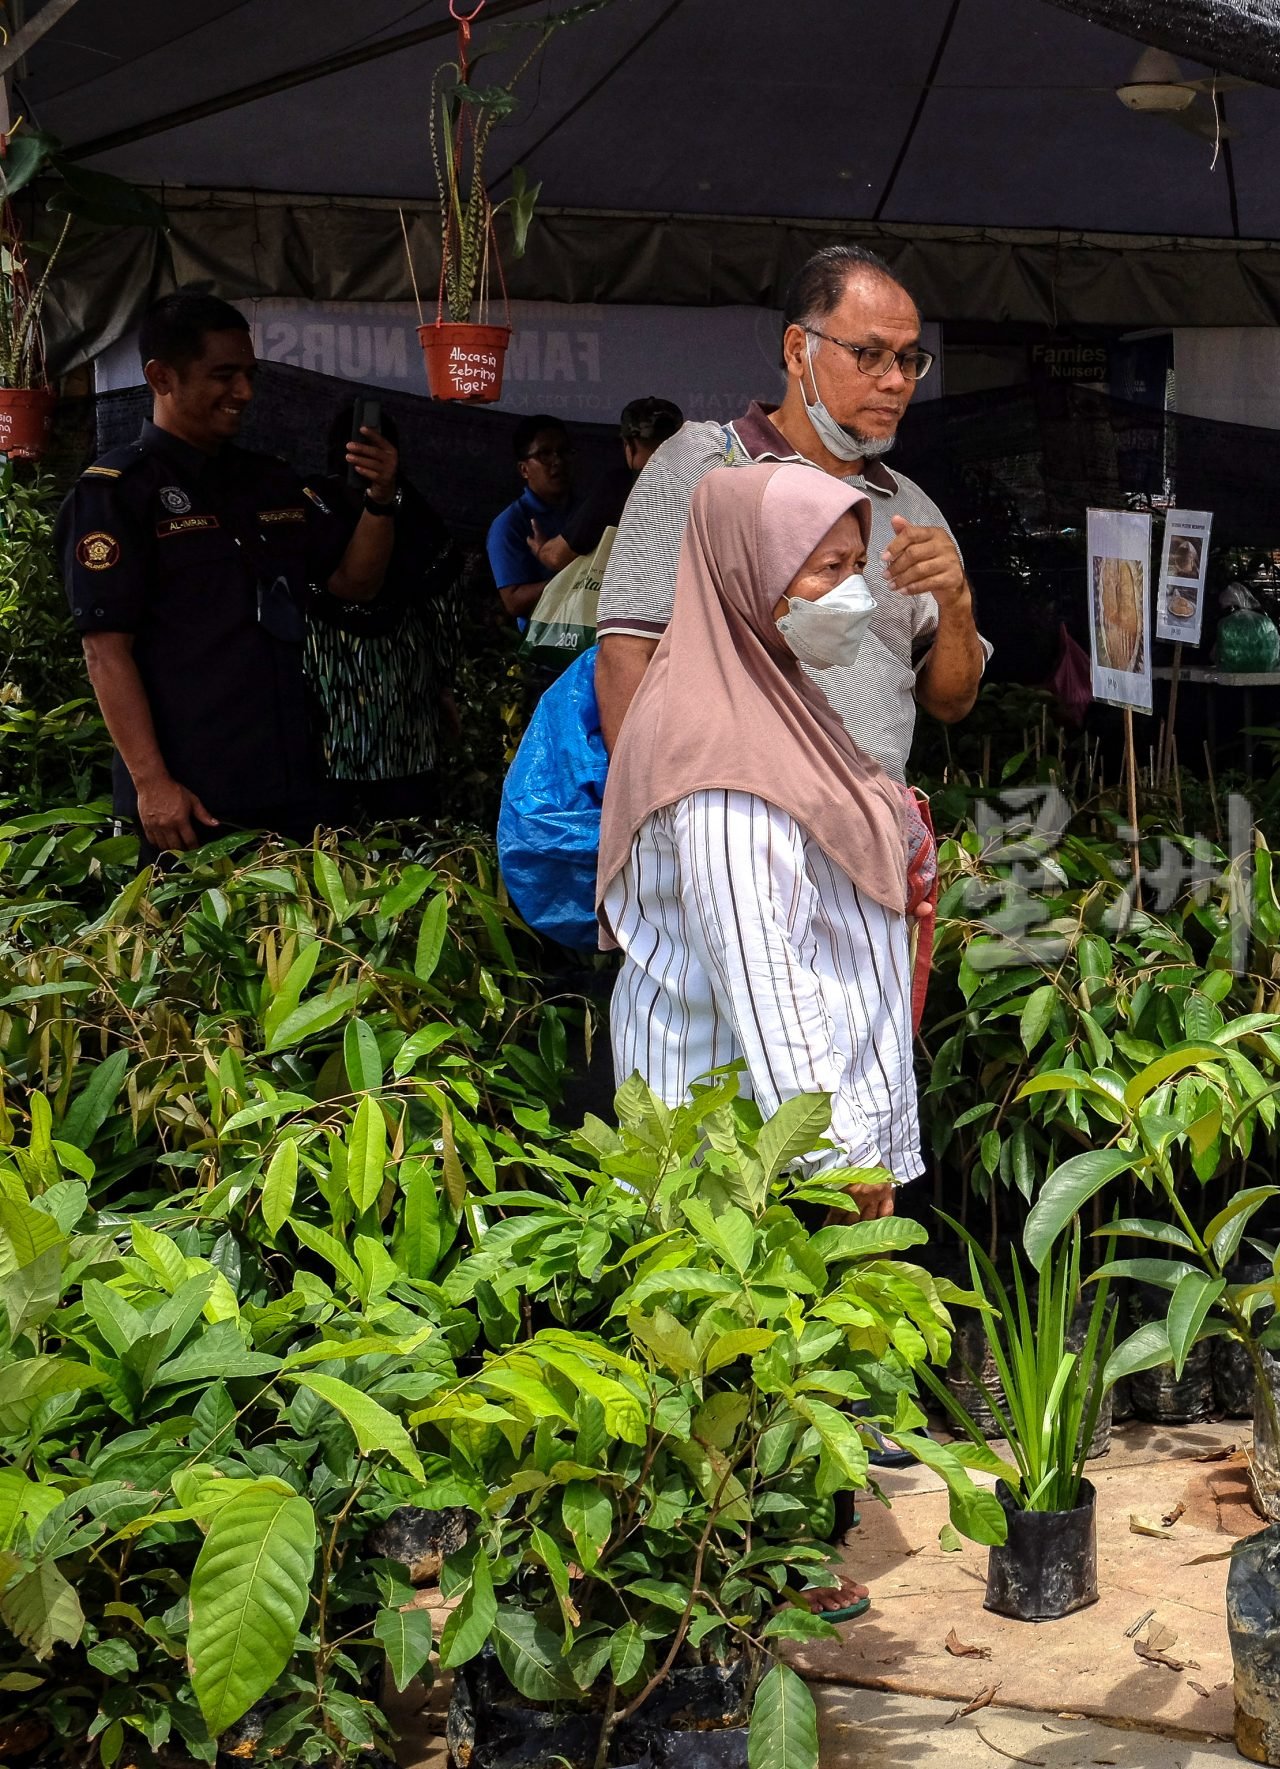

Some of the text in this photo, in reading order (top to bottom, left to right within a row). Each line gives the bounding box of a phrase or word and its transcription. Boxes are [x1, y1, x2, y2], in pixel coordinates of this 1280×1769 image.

[449, 346, 497, 368] Alocasia
[1031, 343, 1107, 364] Famies
[1049, 365, 1107, 381] Nursery
[451, 377, 488, 394] Tiger
[169, 518, 209, 531] AL-IMRAN
